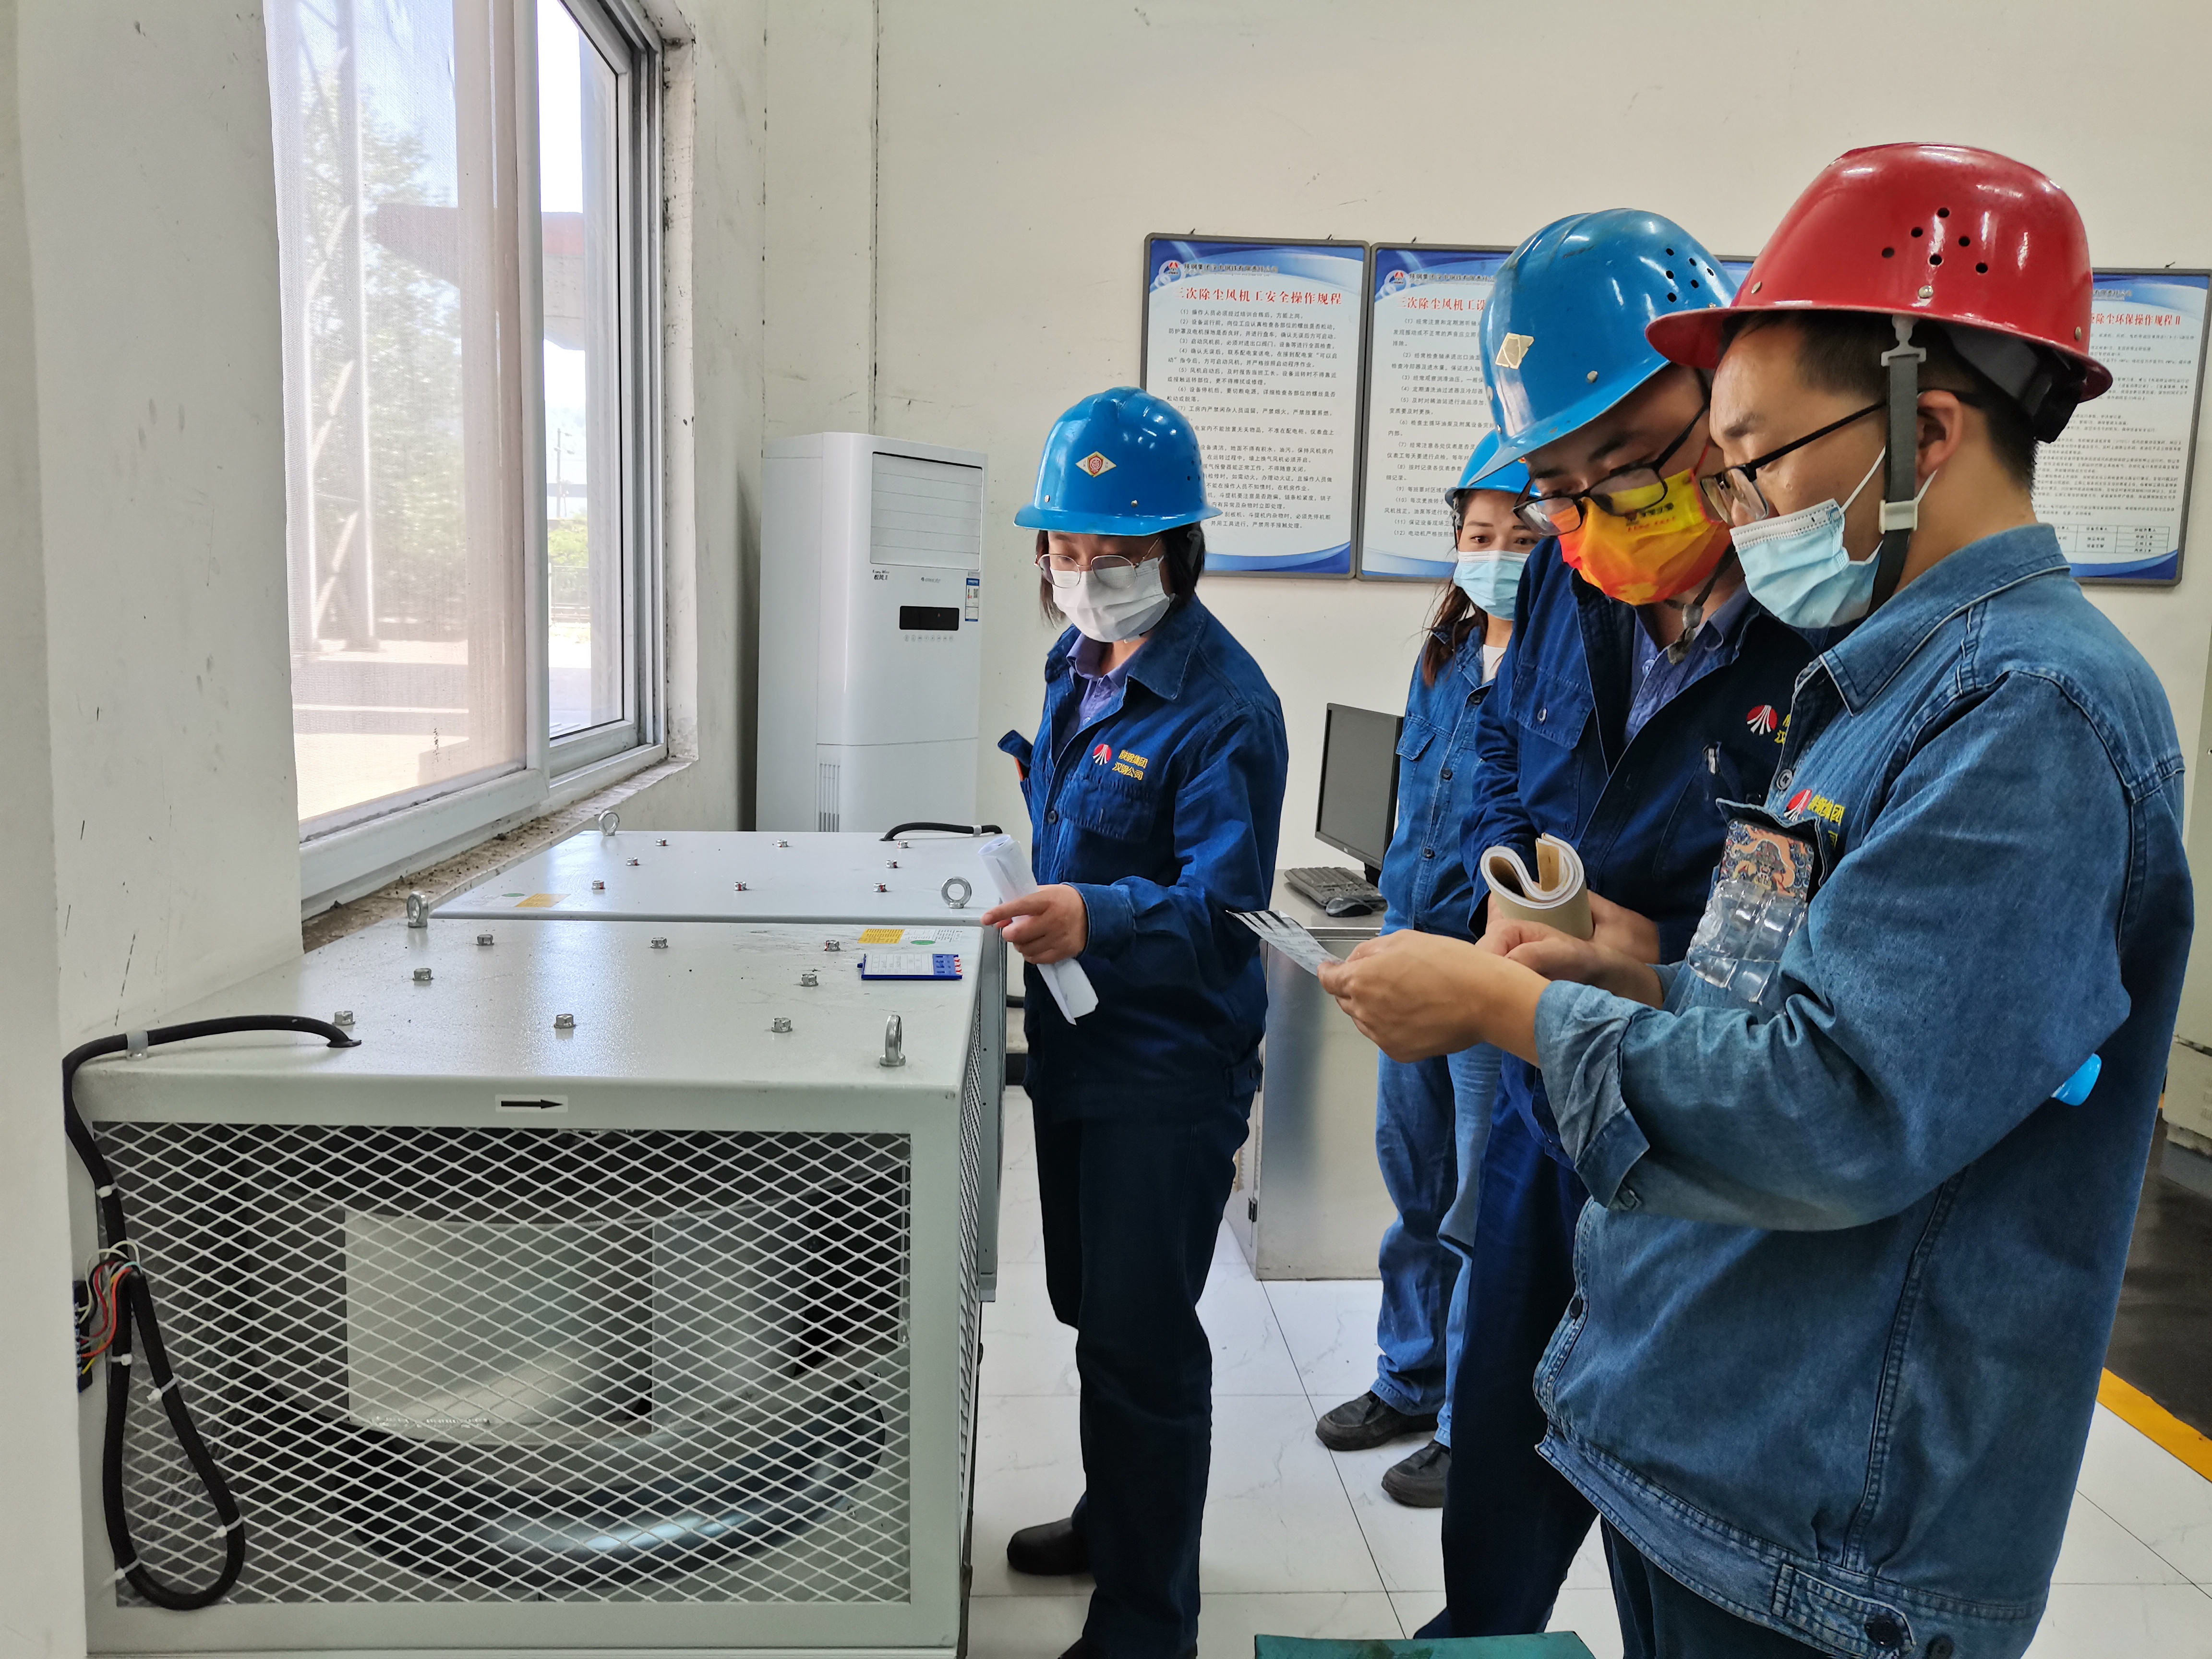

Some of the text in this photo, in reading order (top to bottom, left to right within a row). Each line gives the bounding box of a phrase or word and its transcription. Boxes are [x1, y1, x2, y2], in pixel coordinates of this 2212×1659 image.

[1175, 287, 1342, 305] 三次除尘风机工安全操作规程
[1118, 749, 1148, 769] 陕钢集团
[1112, 761, 1144, 781] 汉钢公司
